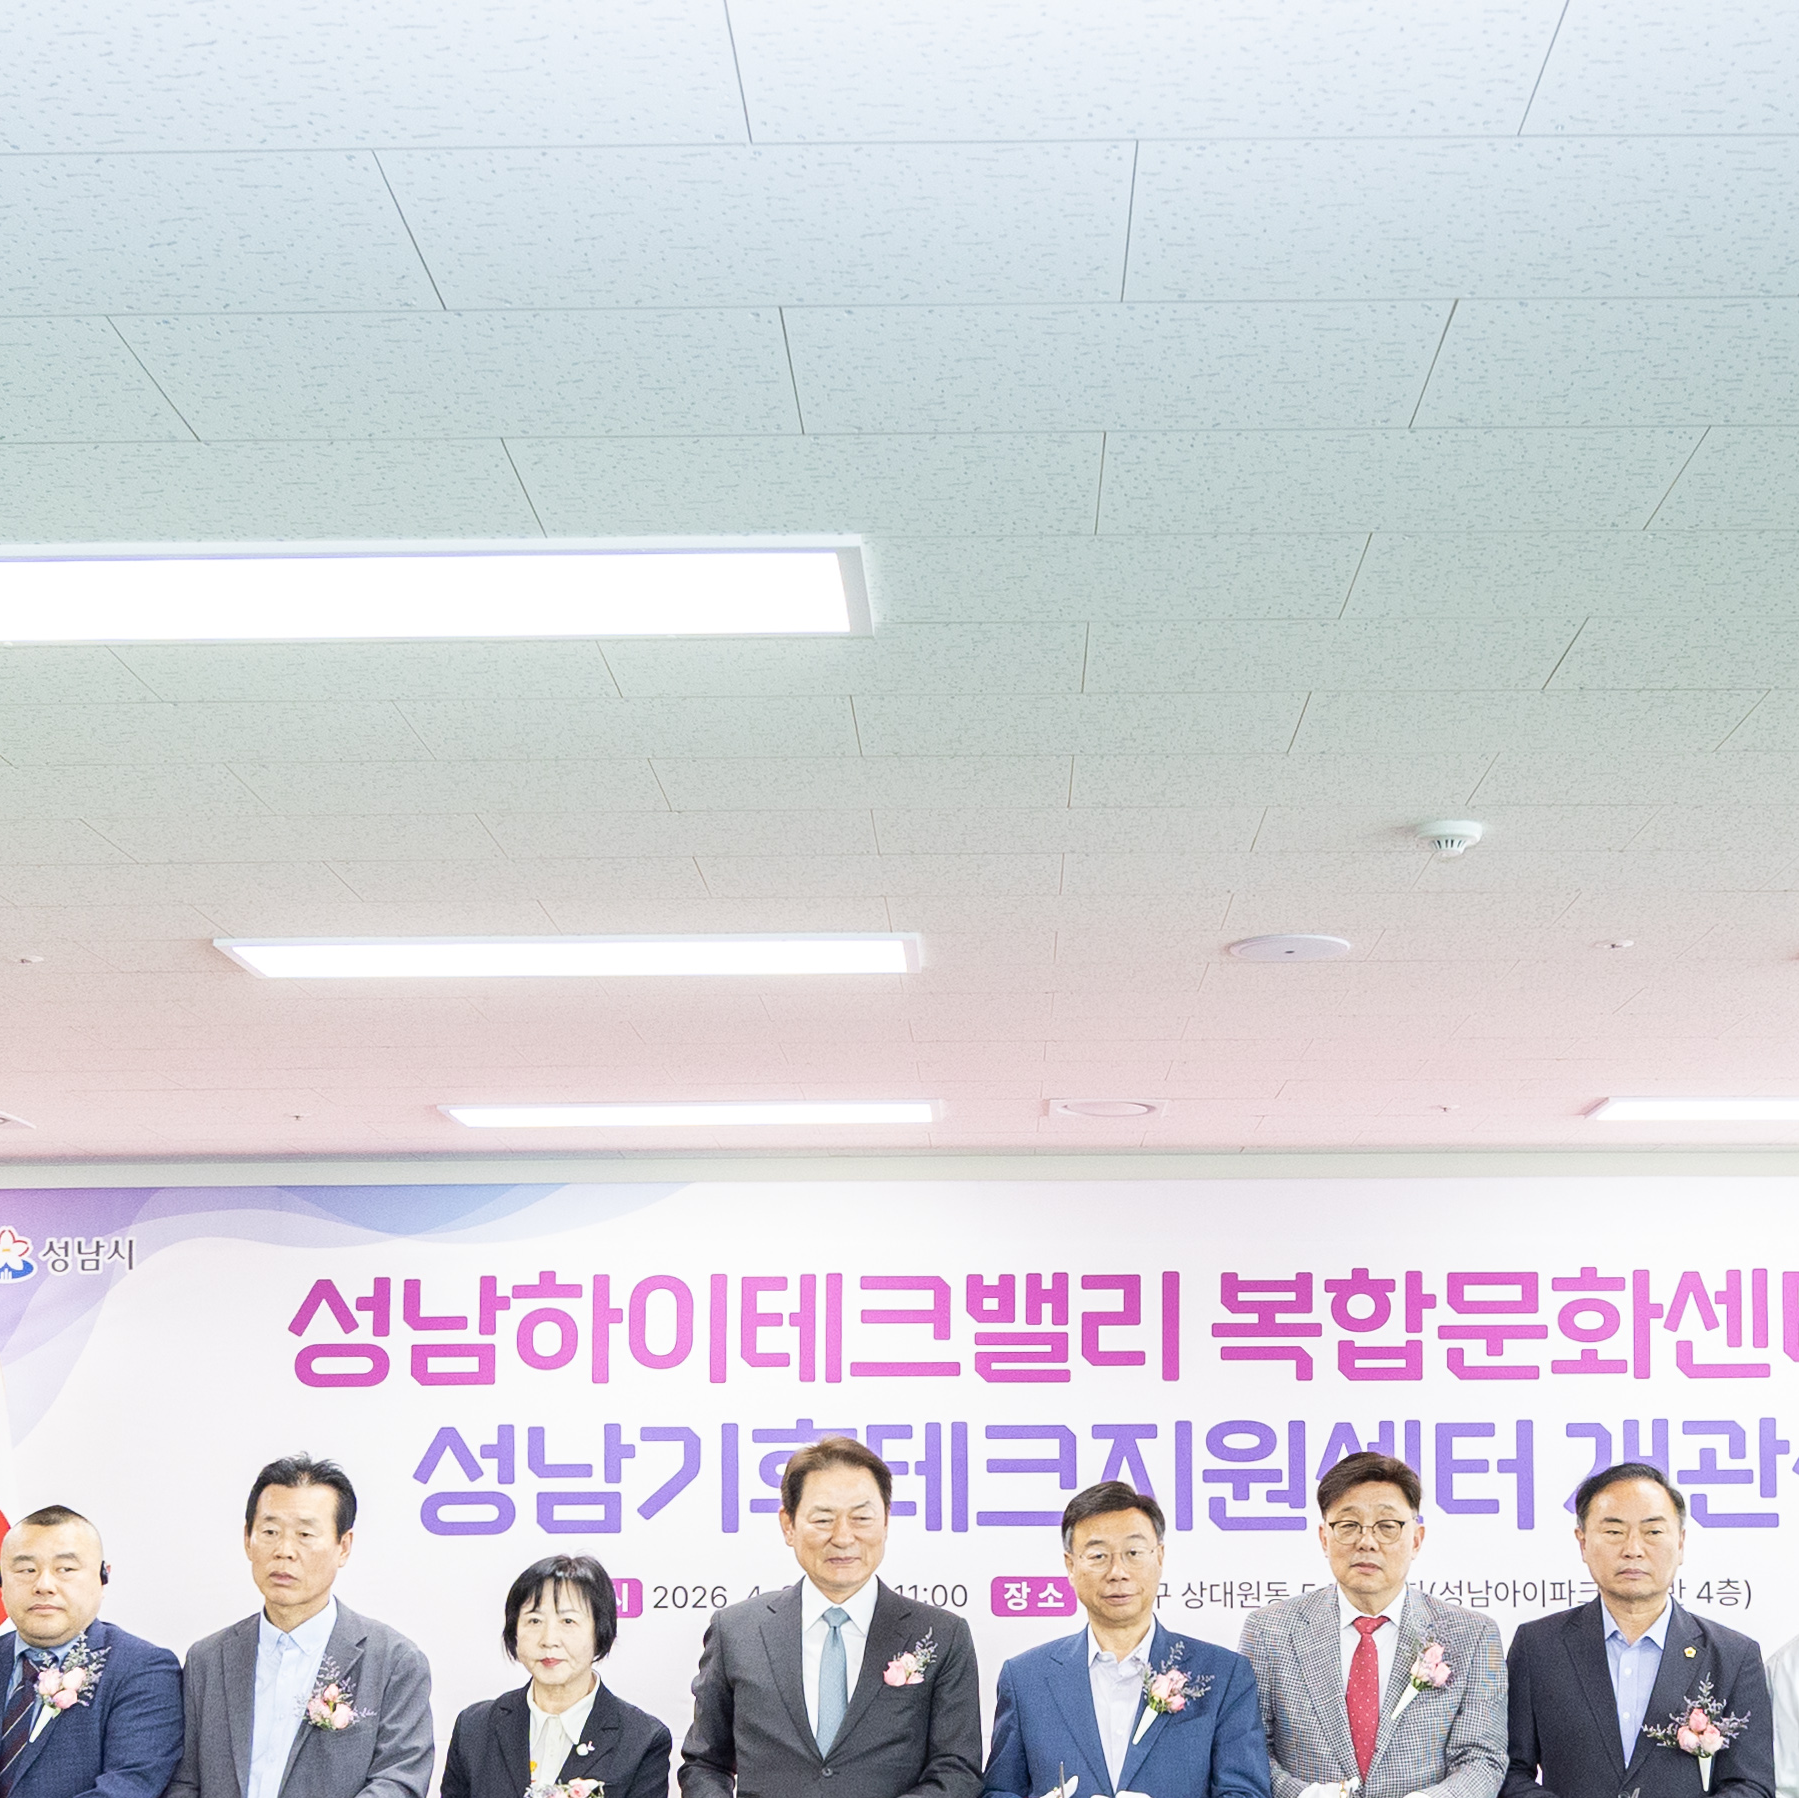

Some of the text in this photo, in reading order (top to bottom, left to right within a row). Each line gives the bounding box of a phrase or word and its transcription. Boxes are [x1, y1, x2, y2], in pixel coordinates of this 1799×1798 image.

[41, 1239, 135, 1273] 성남시
[288, 1269, 1181, 1389] 성남하이테크밸리
[1181, 1580, 1290, 1609] 상대원동
[1696, 1578, 1752, 1610] 4층)
